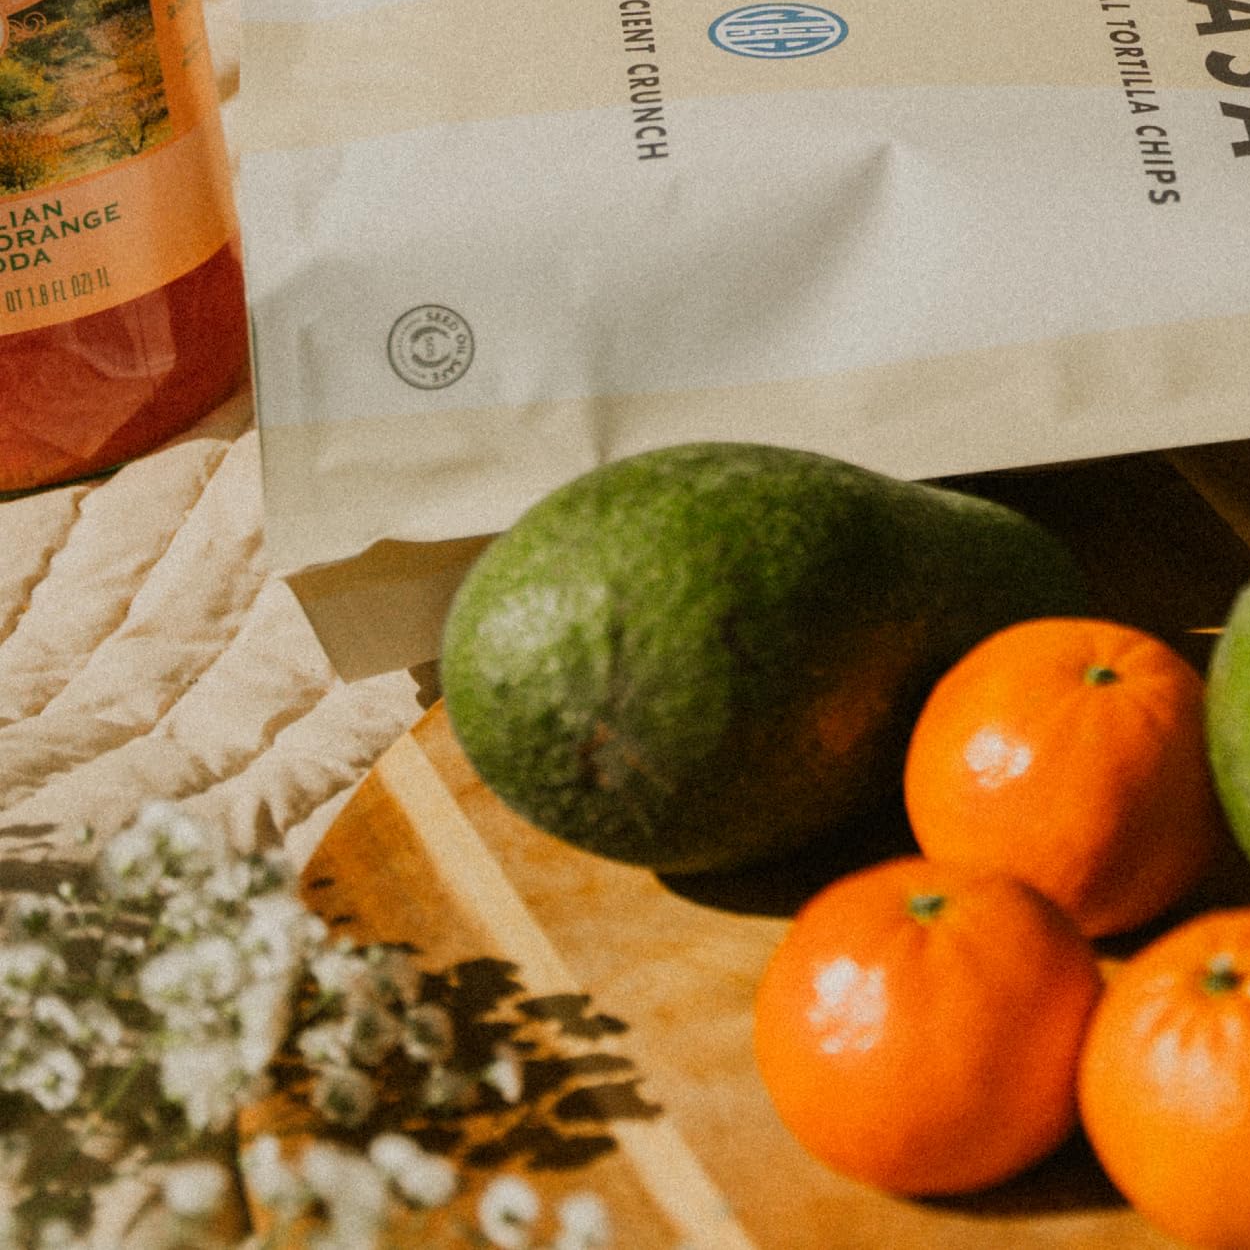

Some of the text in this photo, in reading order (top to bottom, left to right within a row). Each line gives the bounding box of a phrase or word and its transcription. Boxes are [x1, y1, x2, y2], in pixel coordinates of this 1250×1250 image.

[626, 63, 669, 161] CRUNCH
[1106, 19, 1161, 114] TORTILLA
[1135, 124, 1181, 206] CHIPS
[51, 280, 68, 302] FL
